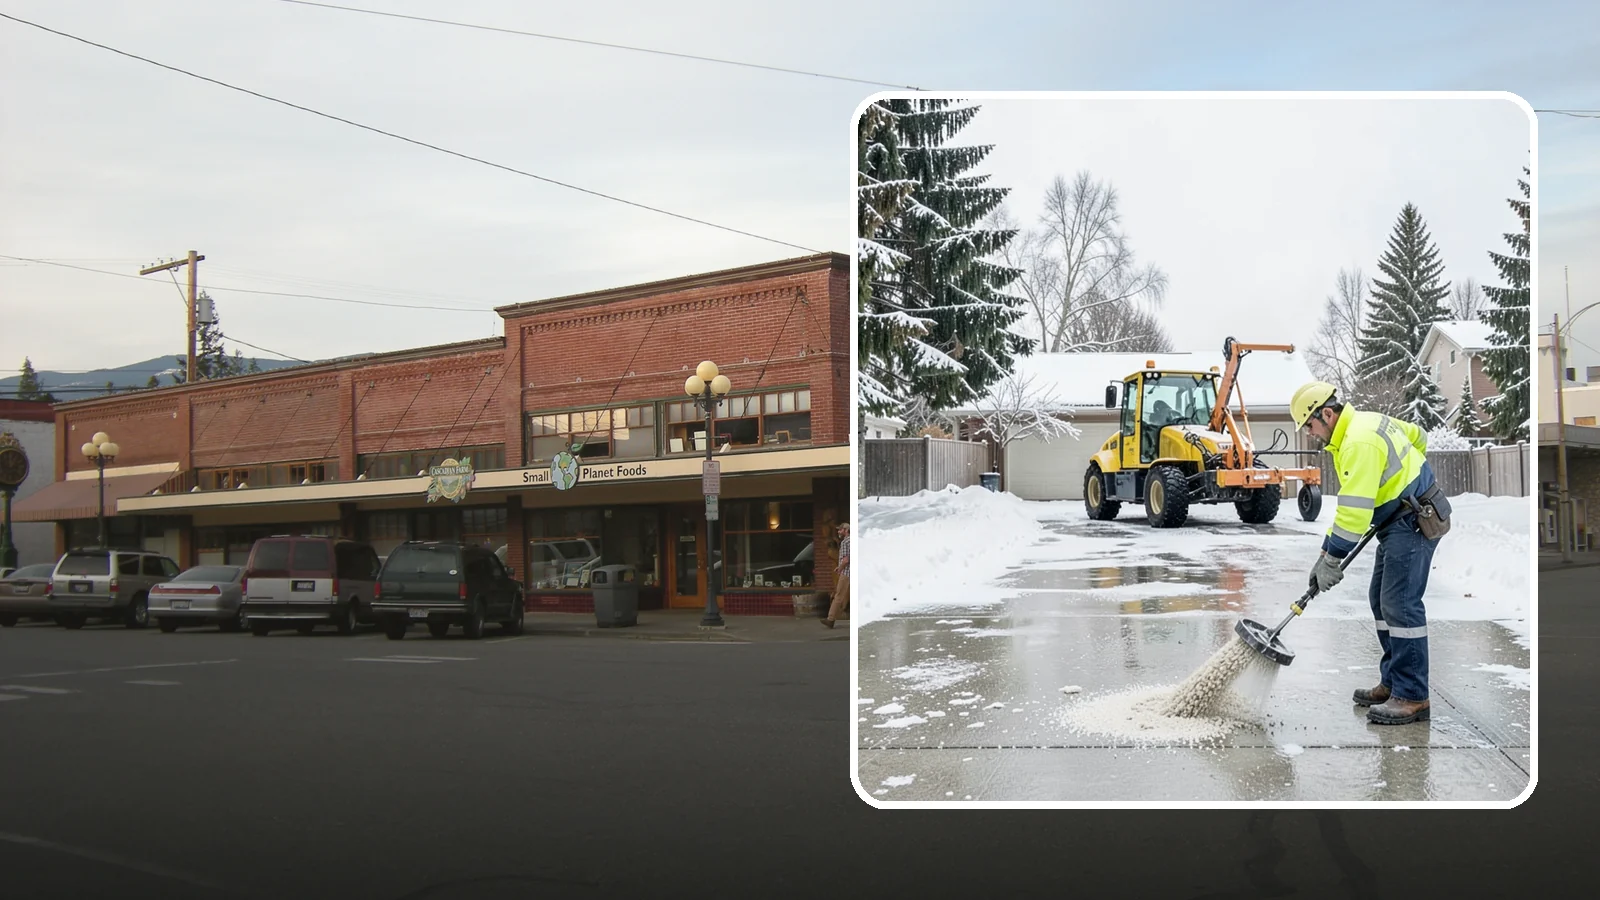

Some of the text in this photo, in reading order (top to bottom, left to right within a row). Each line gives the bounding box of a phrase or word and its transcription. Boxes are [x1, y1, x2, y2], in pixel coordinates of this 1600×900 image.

[523, 464, 647, 483] Small Planet Foods
